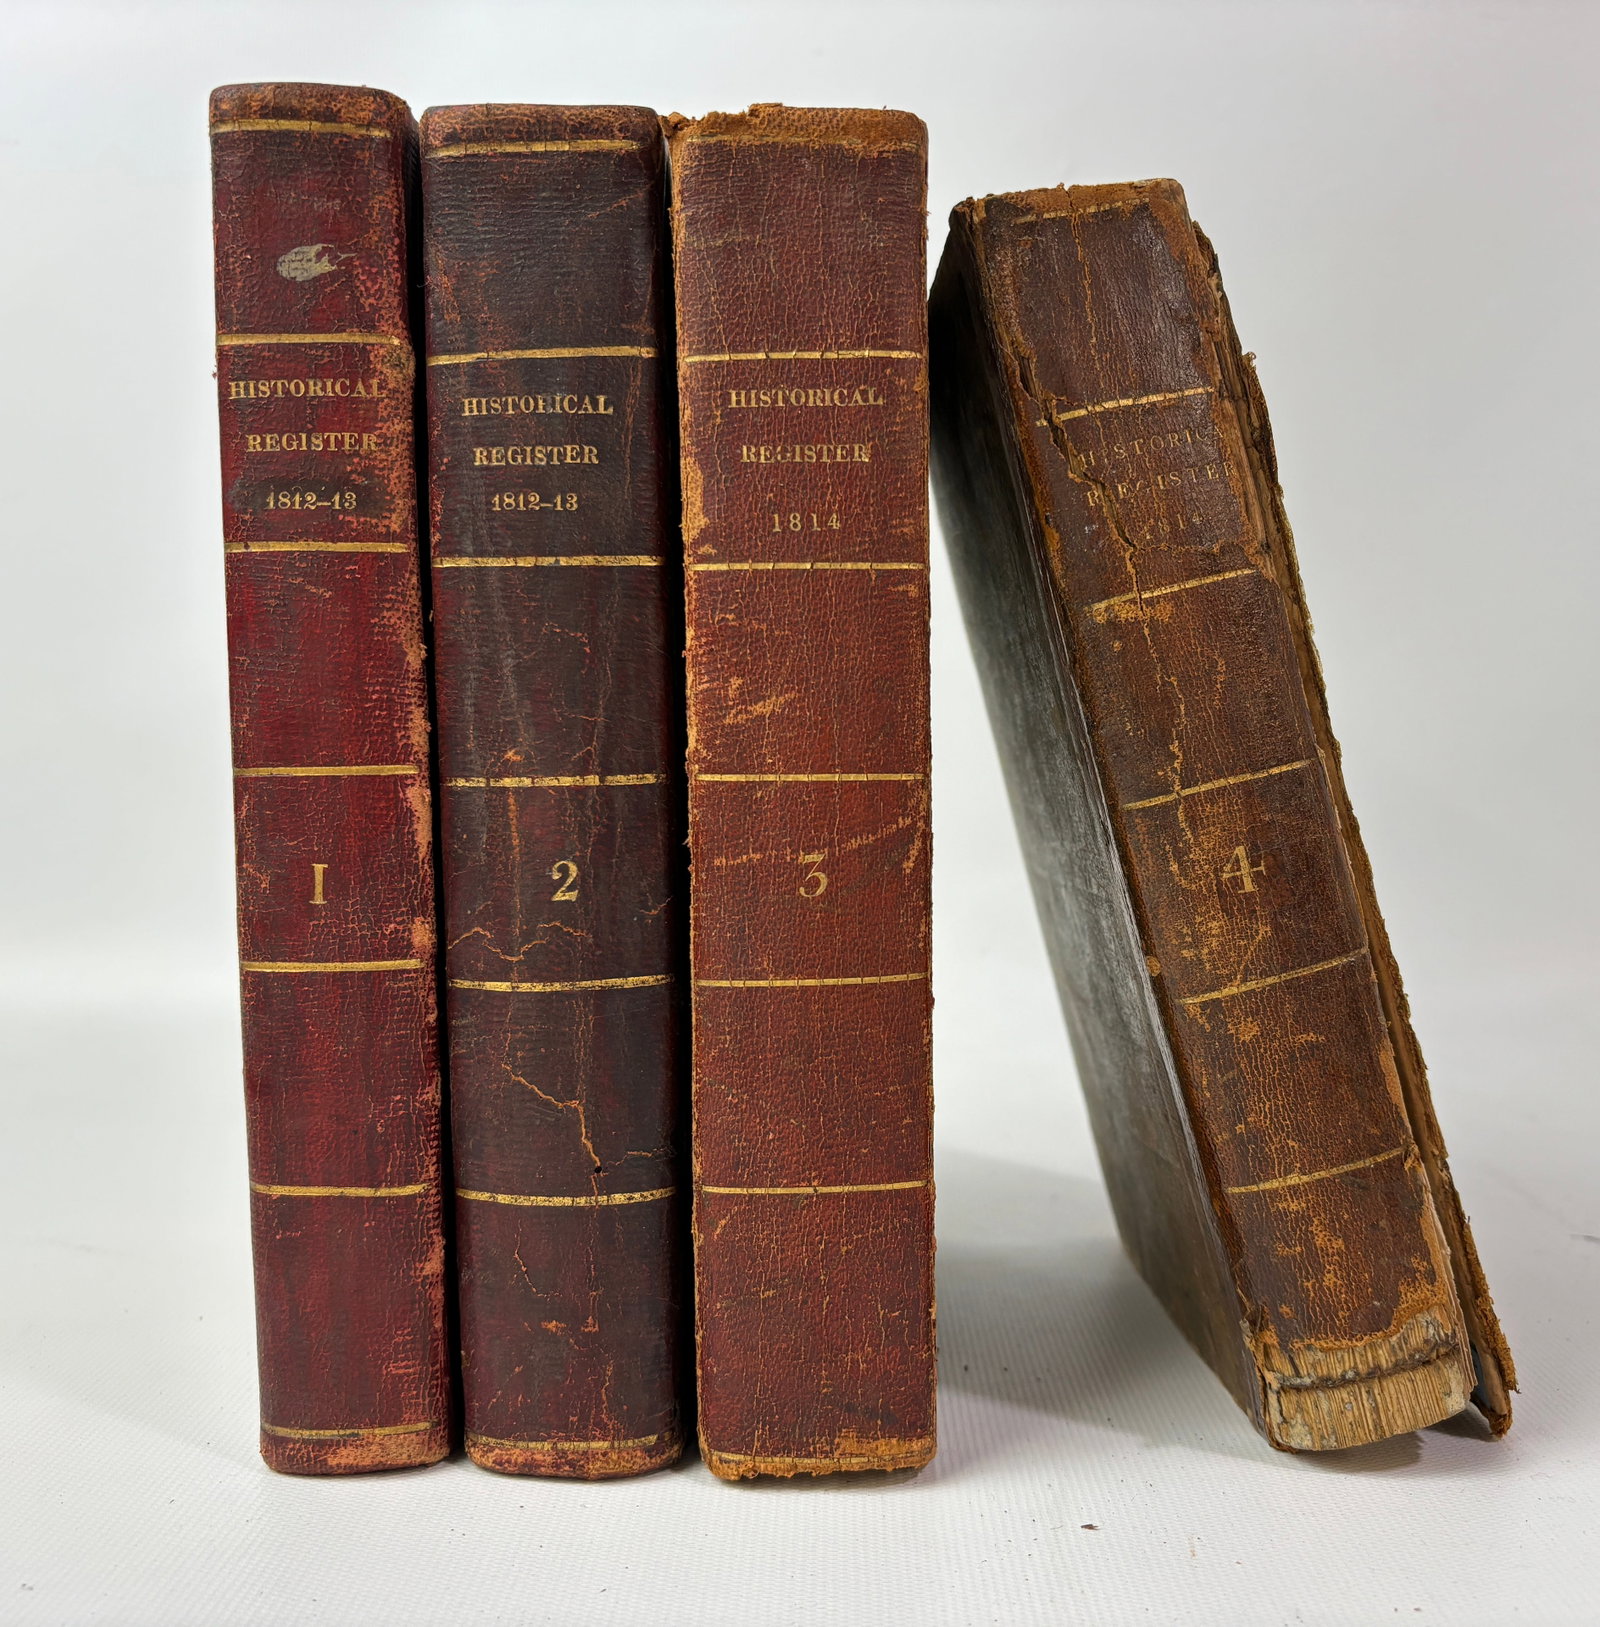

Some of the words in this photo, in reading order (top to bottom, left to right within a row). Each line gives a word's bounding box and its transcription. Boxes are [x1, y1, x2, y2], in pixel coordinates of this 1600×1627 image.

[228, 378, 387, 400] HISTORICAL
[728, 386, 884, 408] HISTORICAL
[246, 432, 379, 452] REGISTER
[473, 443, 600, 466] REGISTER
[740, 443, 872, 464] REGISTER
[772, 512, 841, 532] 1814
[799, 853, 828, 898] 3
[1219, 845, 1266, 894] 4
[551, 860, 579, 902] 2
